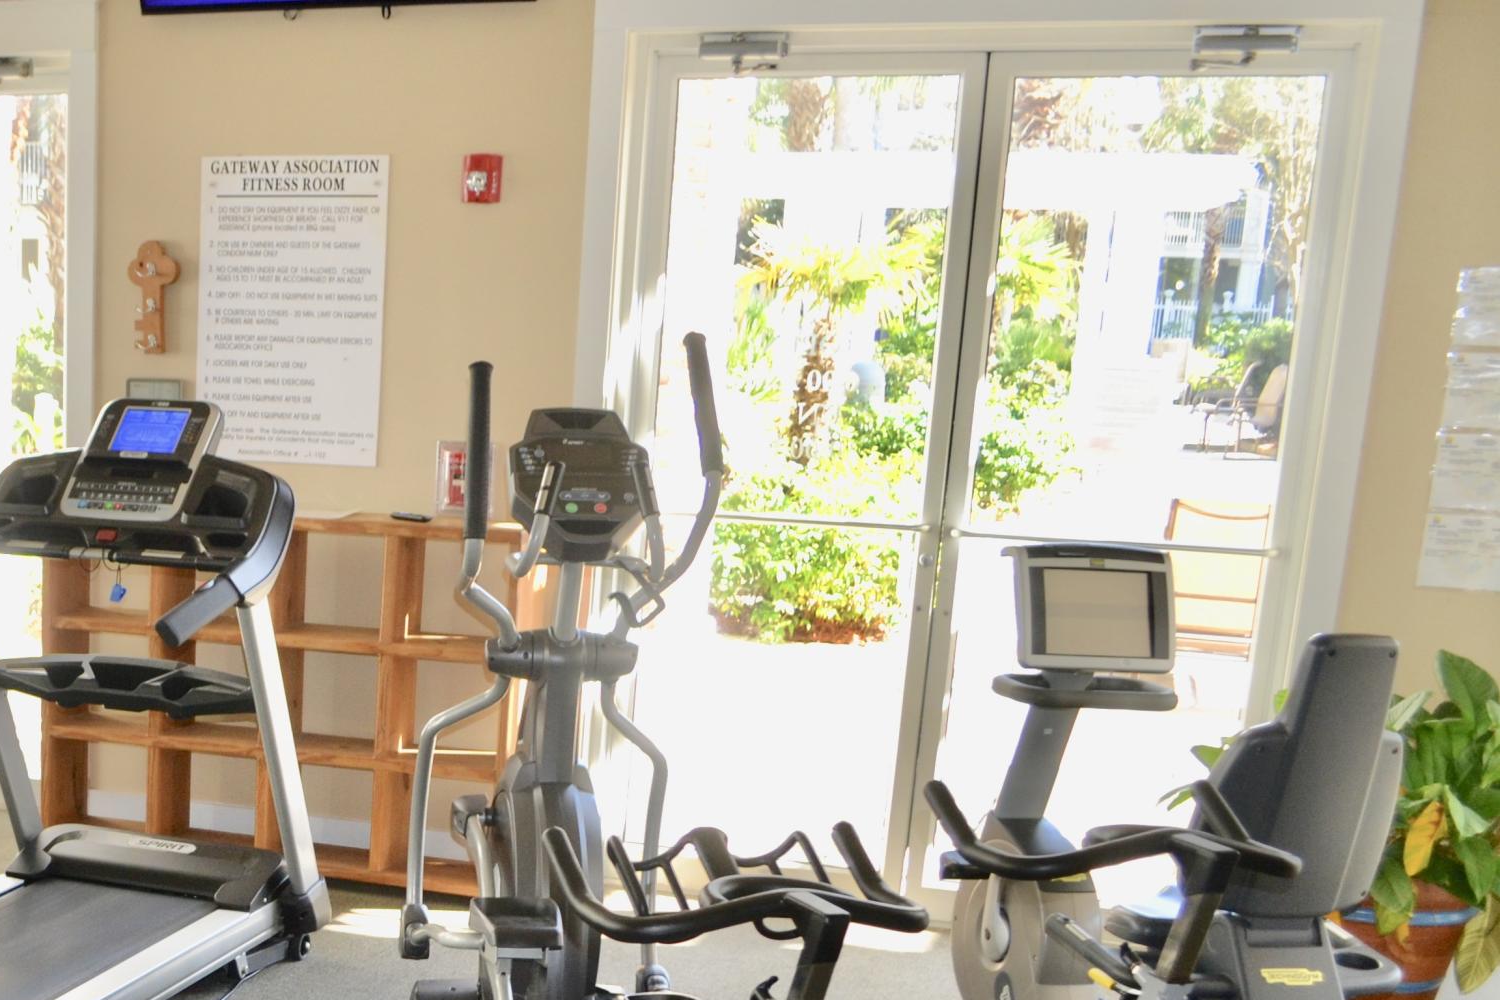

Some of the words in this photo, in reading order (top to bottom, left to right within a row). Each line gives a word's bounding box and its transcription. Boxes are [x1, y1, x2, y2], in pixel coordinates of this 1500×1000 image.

[211, 160, 279, 175] GATEWAY
[283, 159, 380, 173] ASSOCIATION
[242, 178, 298, 192] FITNESS
[303, 177, 345, 191] ROOM
